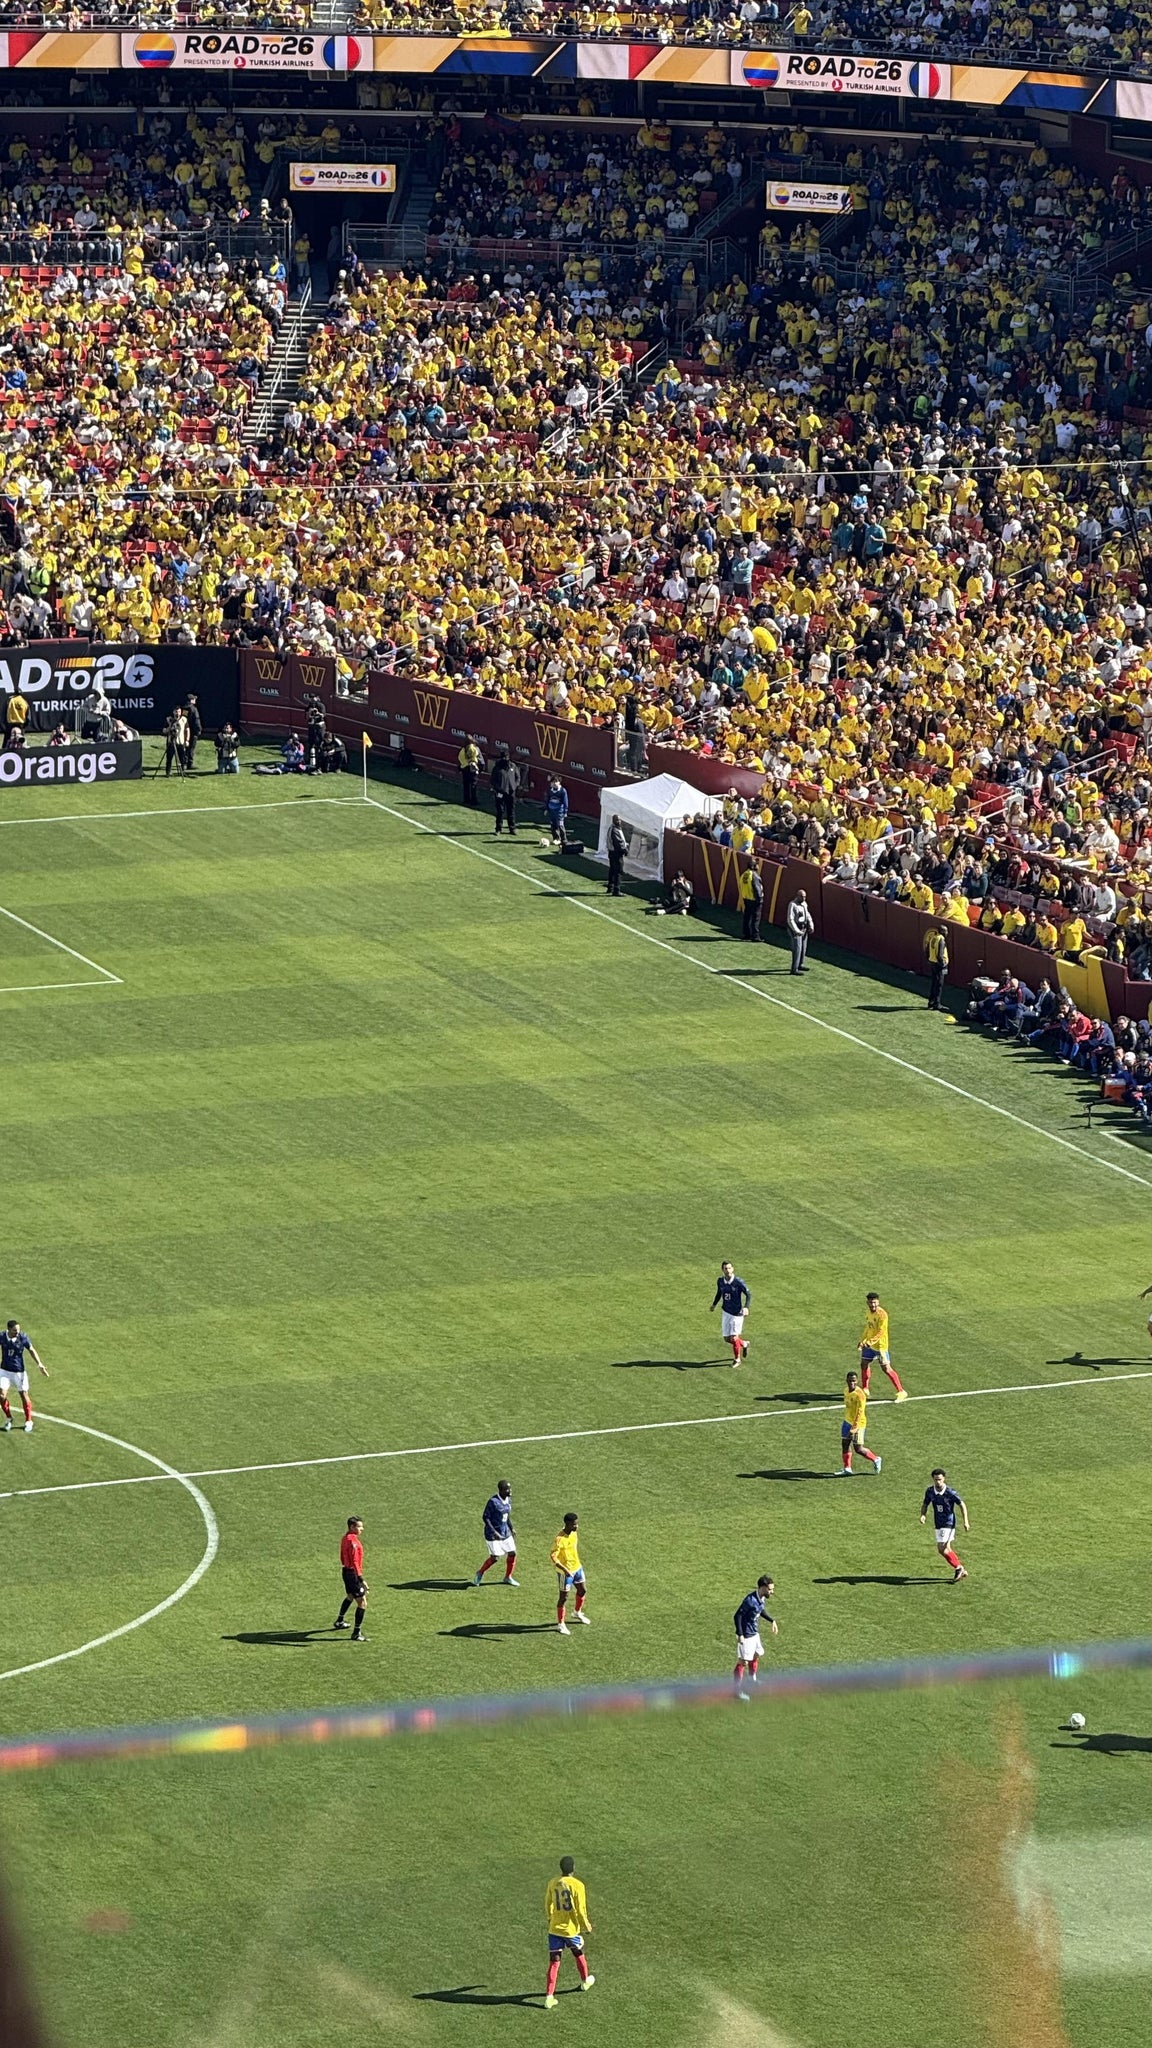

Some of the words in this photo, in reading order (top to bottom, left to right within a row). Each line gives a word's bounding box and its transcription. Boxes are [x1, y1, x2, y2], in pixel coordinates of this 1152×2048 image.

[184, 35, 260, 54] ROAD
[261, 43, 280, 55] TO
[787, 55, 856, 76] ROAD
[857, 67, 874, 78] TO
[846, 82, 873, 90] TURKISH
[875, 83, 902, 93] AIRLINES
[318, 171, 347, 179] ROAD
[792, 190, 819, 199] ROAD
[54, 669, 90, 691] TO
[260, 687, 280, 695] CLARK
[0, 752, 117, 783] Orange
[554, 1888, 573, 1912] 13
